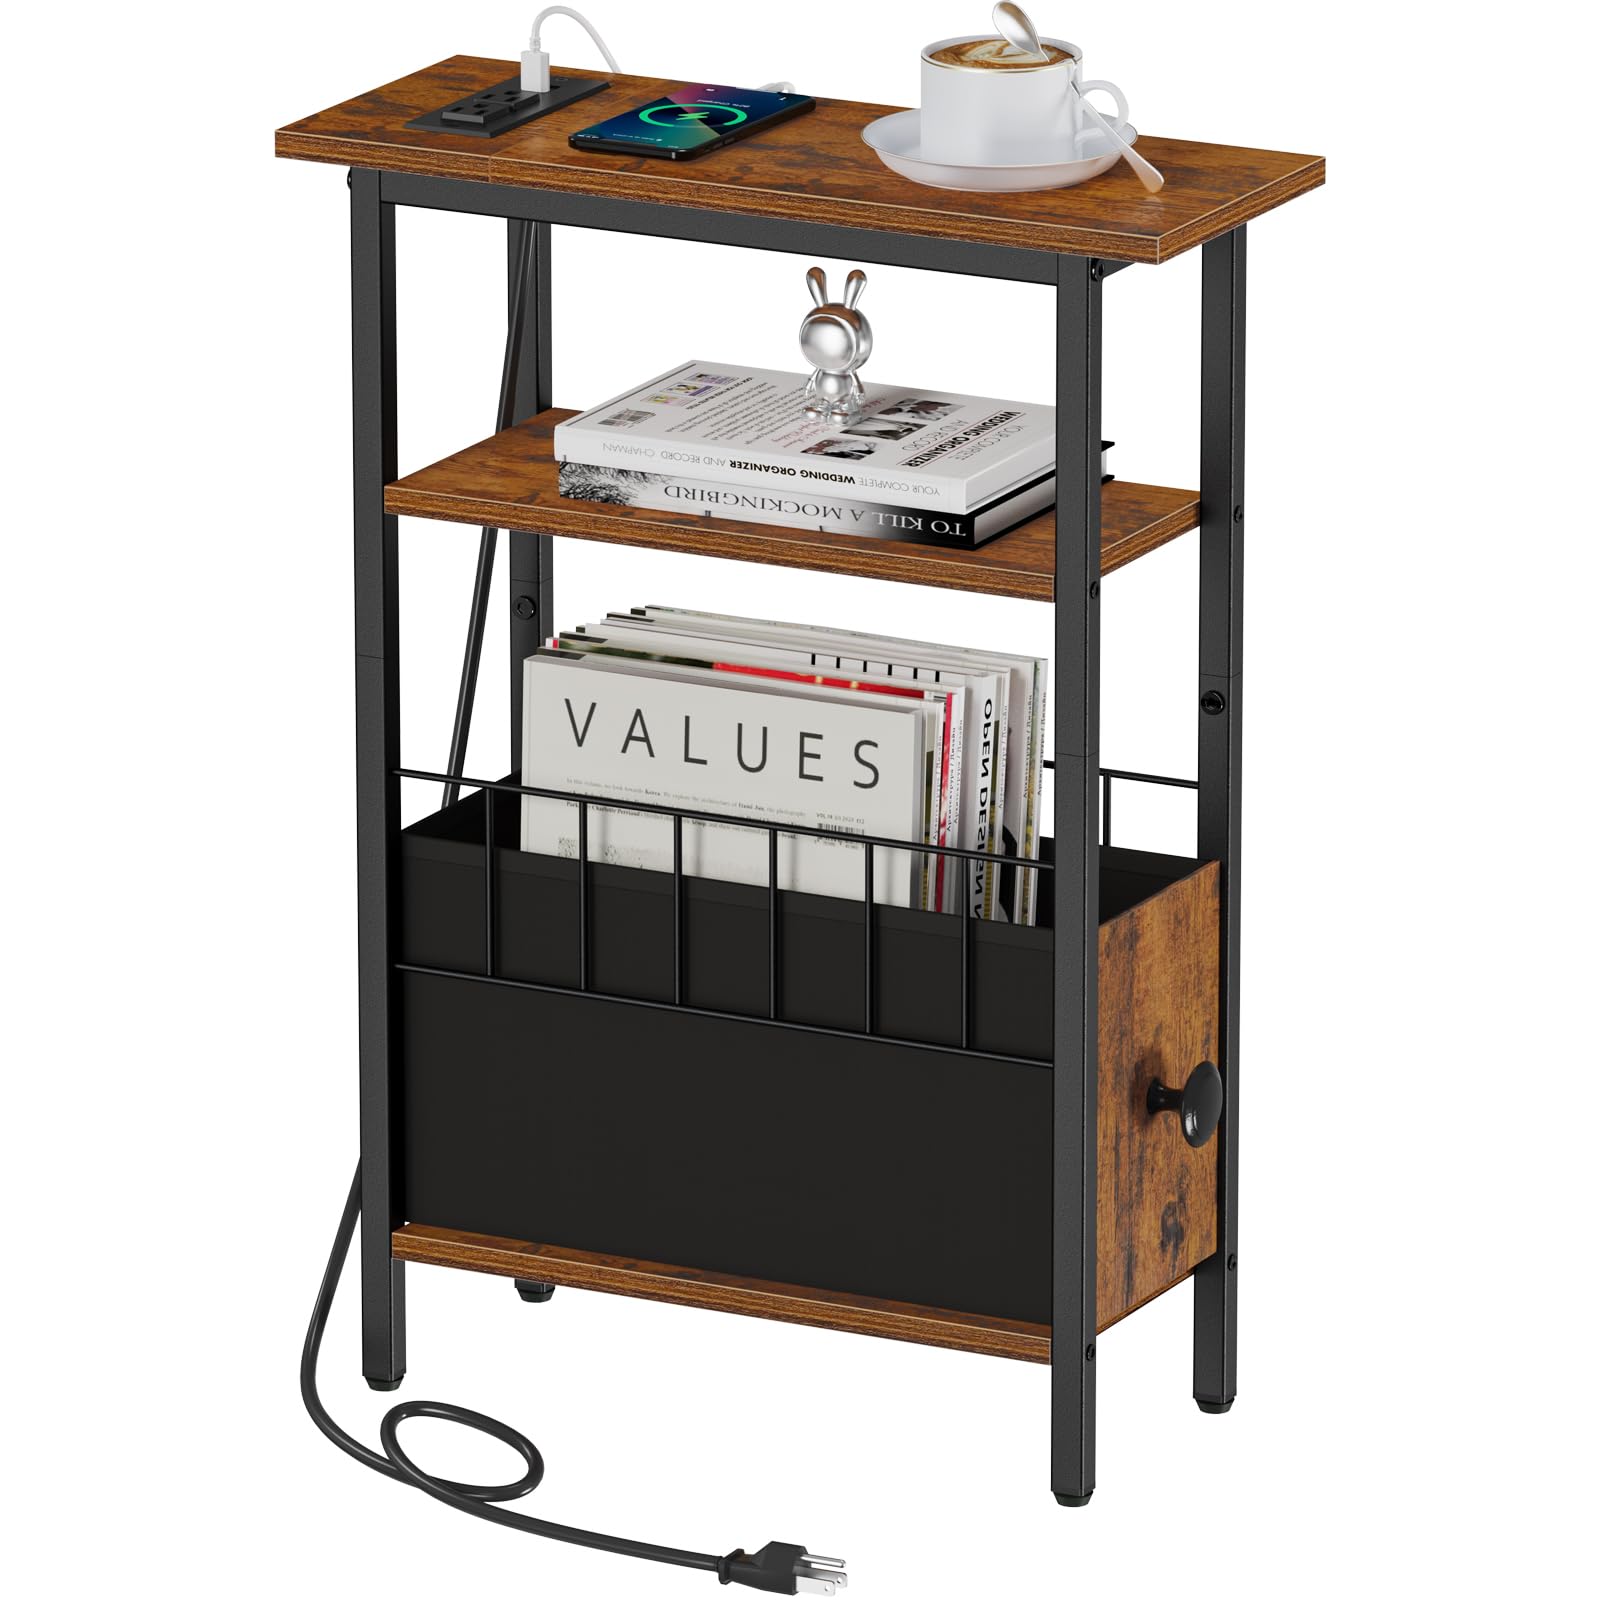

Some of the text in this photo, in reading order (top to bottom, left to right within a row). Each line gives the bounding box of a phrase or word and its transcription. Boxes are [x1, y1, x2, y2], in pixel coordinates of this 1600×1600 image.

[602, 442, 656, 458] CHAPMAN
[900, 411, 1022, 468] WEDDING ORGANIZER
[901, 431, 951, 452] RECORD
[660, 450, 941, 496] YOUR COMPLETE WEDDING ORGANIZER AND RECORD
[663, 484, 967, 537] TO KILL A MOCKINGBIRD
[564, 697, 880, 789] VALUES
